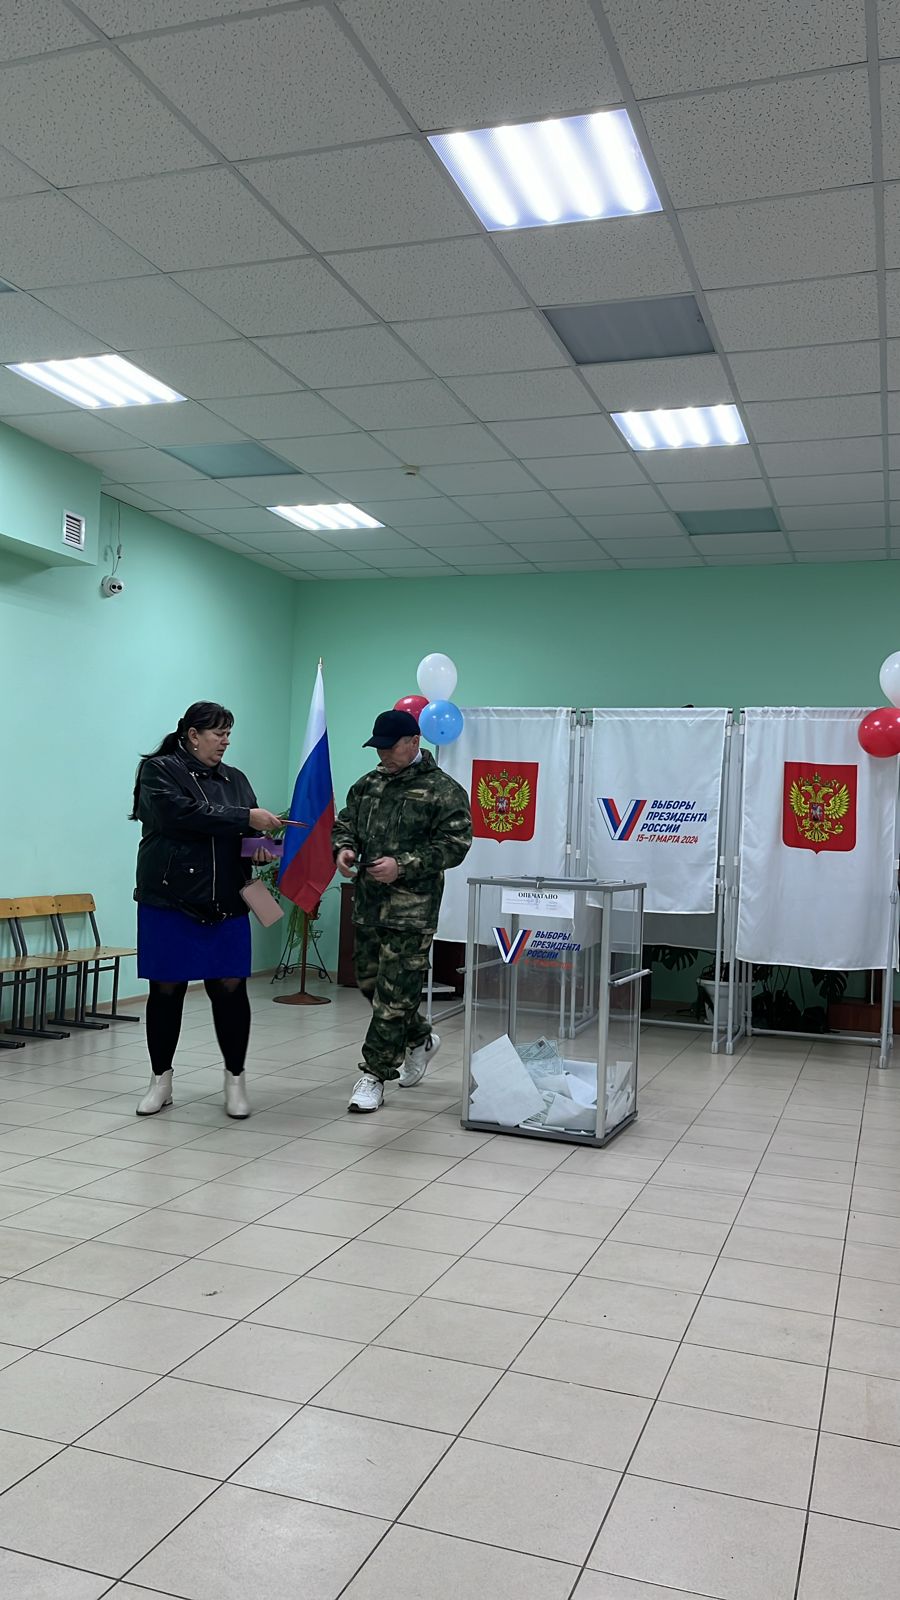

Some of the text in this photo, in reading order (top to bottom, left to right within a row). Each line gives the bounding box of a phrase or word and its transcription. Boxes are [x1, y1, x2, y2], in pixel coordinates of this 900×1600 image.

[651, 800, 696, 810] ВЫБОРЫ
[646, 811, 707, 823] ПРЕЗИДЕНТА
[640, 823, 681, 833] РОССИИ
[655, 834, 680, 844] МАРТА
[681, 835, 698, 844] 2024
[518, 892, 558, 900] ОПЕЧАТАНО
[535, 931, 571, 941] ВЫБОРЫ
[530, 940, 581, 952] ПРЕЗИДЕНТА
[526, 950, 559, 960] РОССИИ
